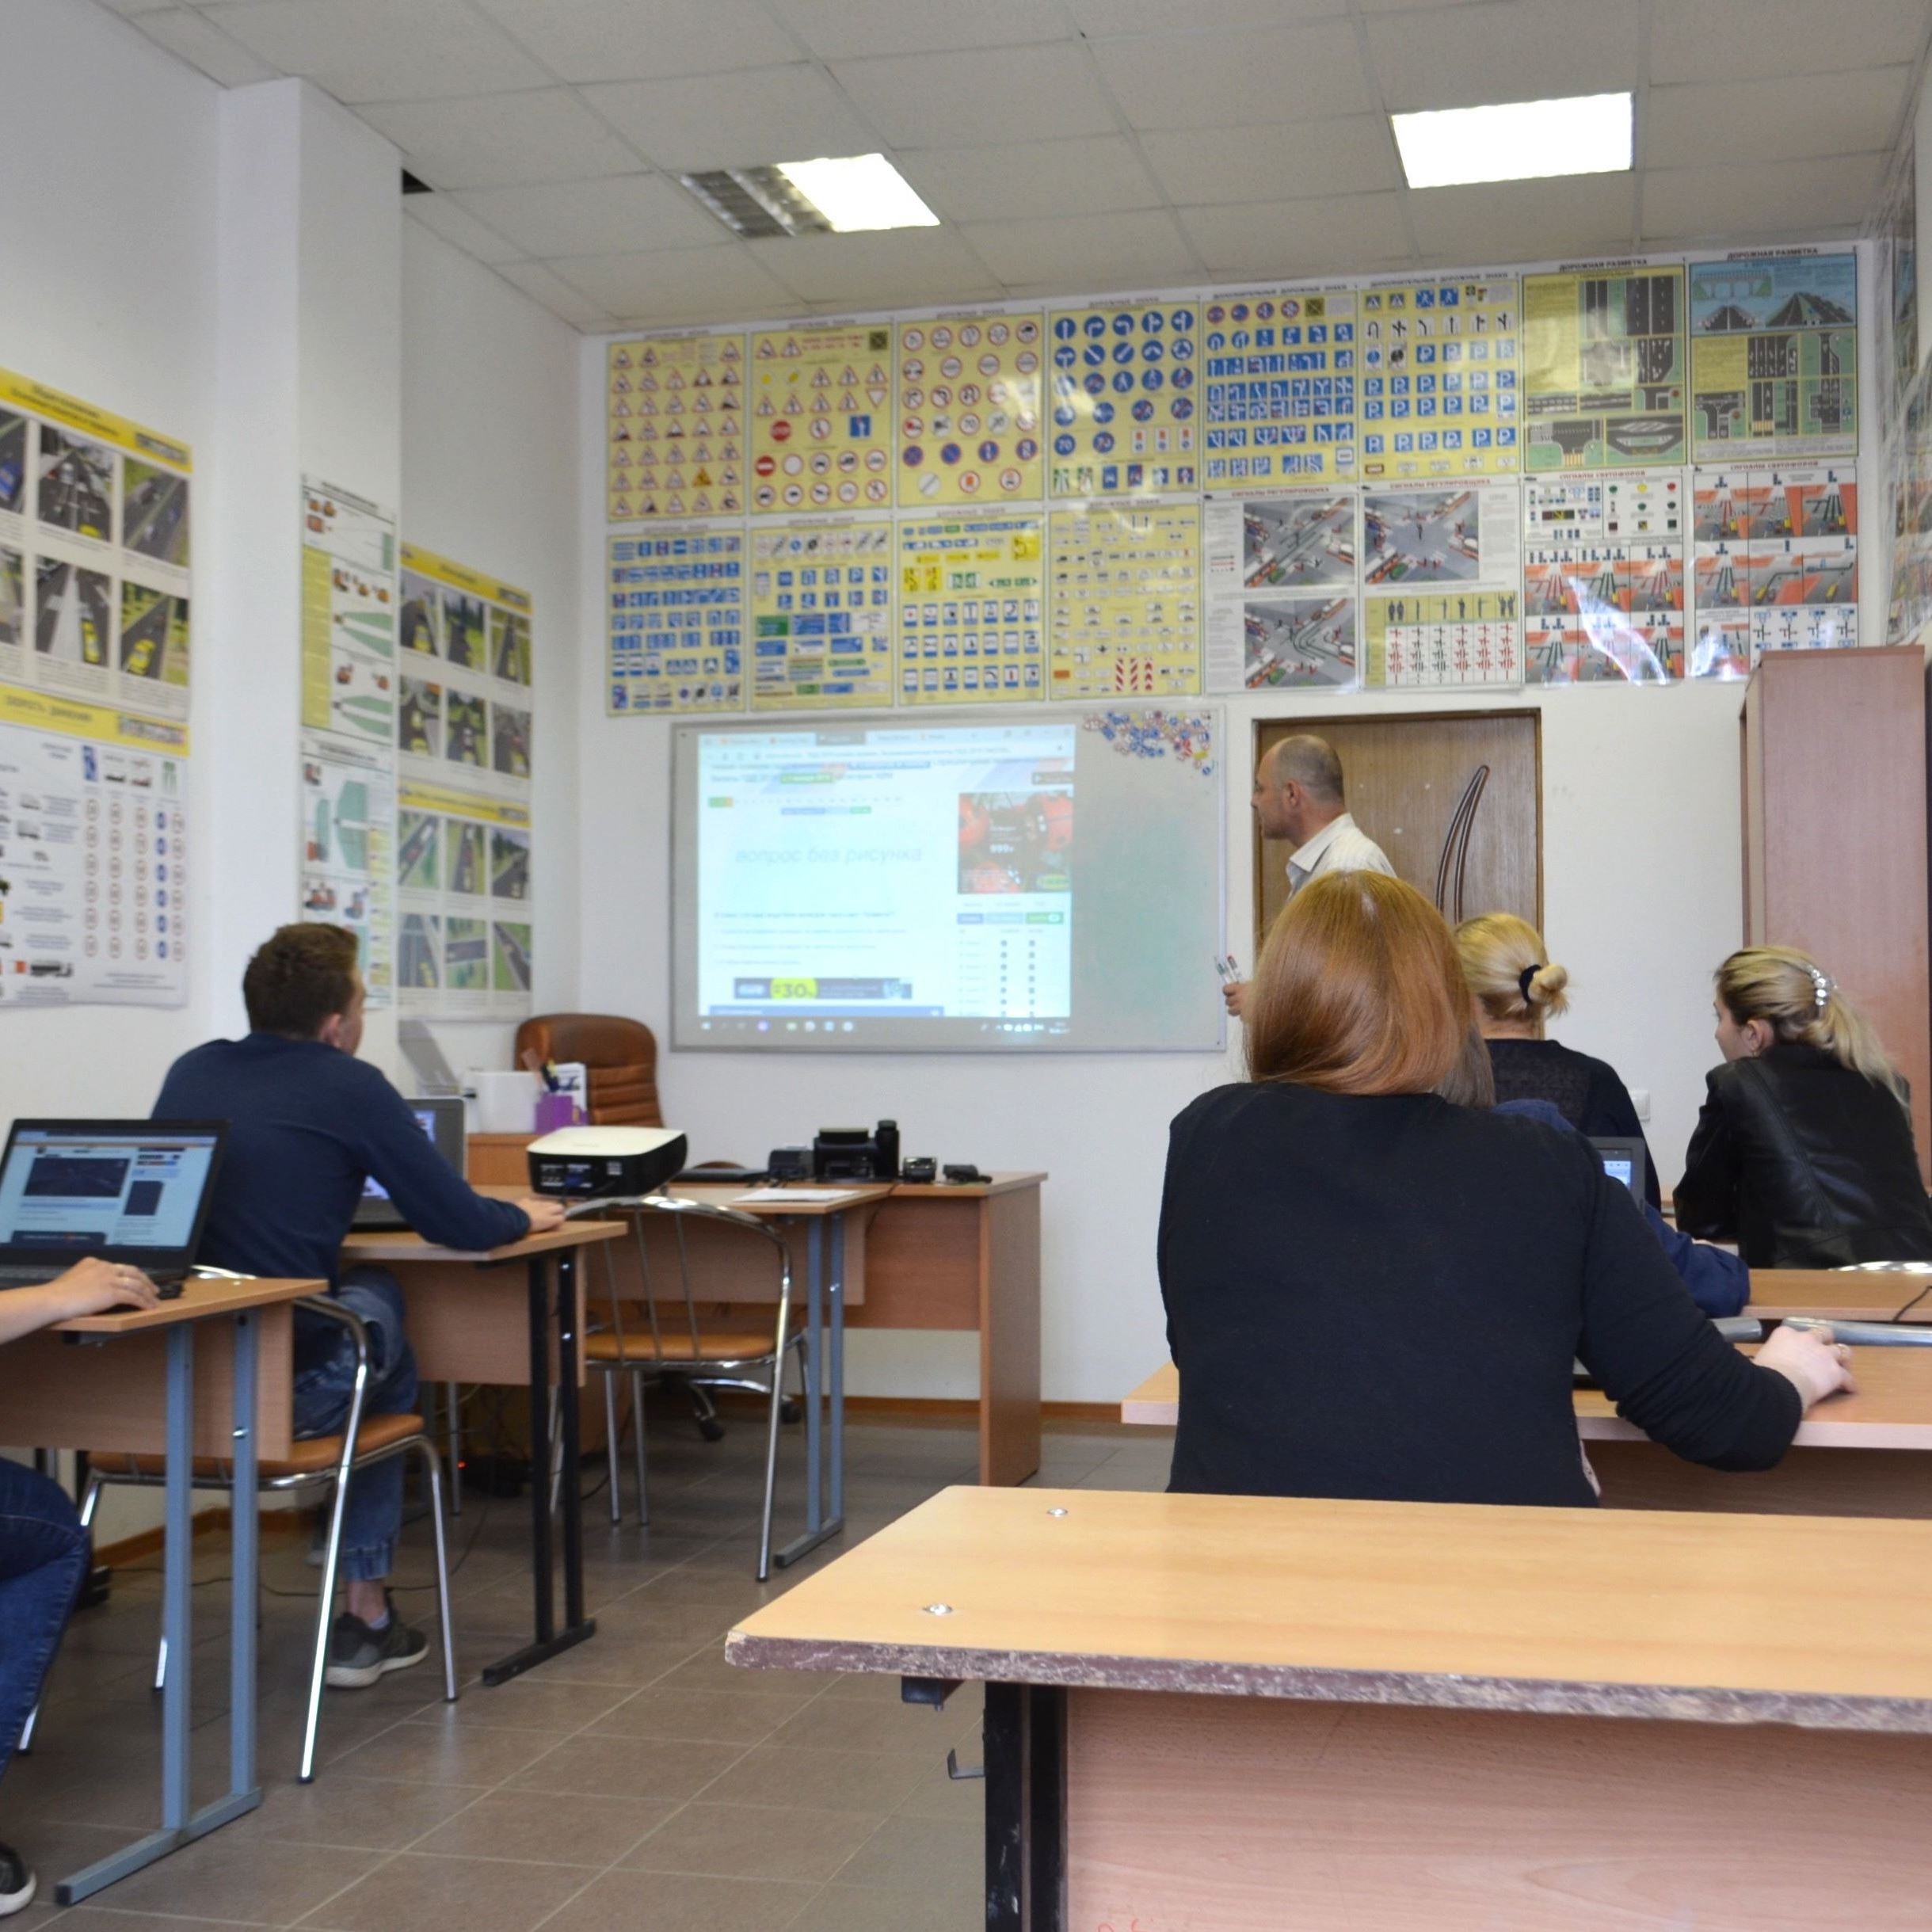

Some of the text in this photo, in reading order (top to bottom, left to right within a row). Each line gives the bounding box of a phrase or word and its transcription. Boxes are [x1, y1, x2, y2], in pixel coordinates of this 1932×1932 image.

[736, 845, 923, 867] вопрос без рисунка
